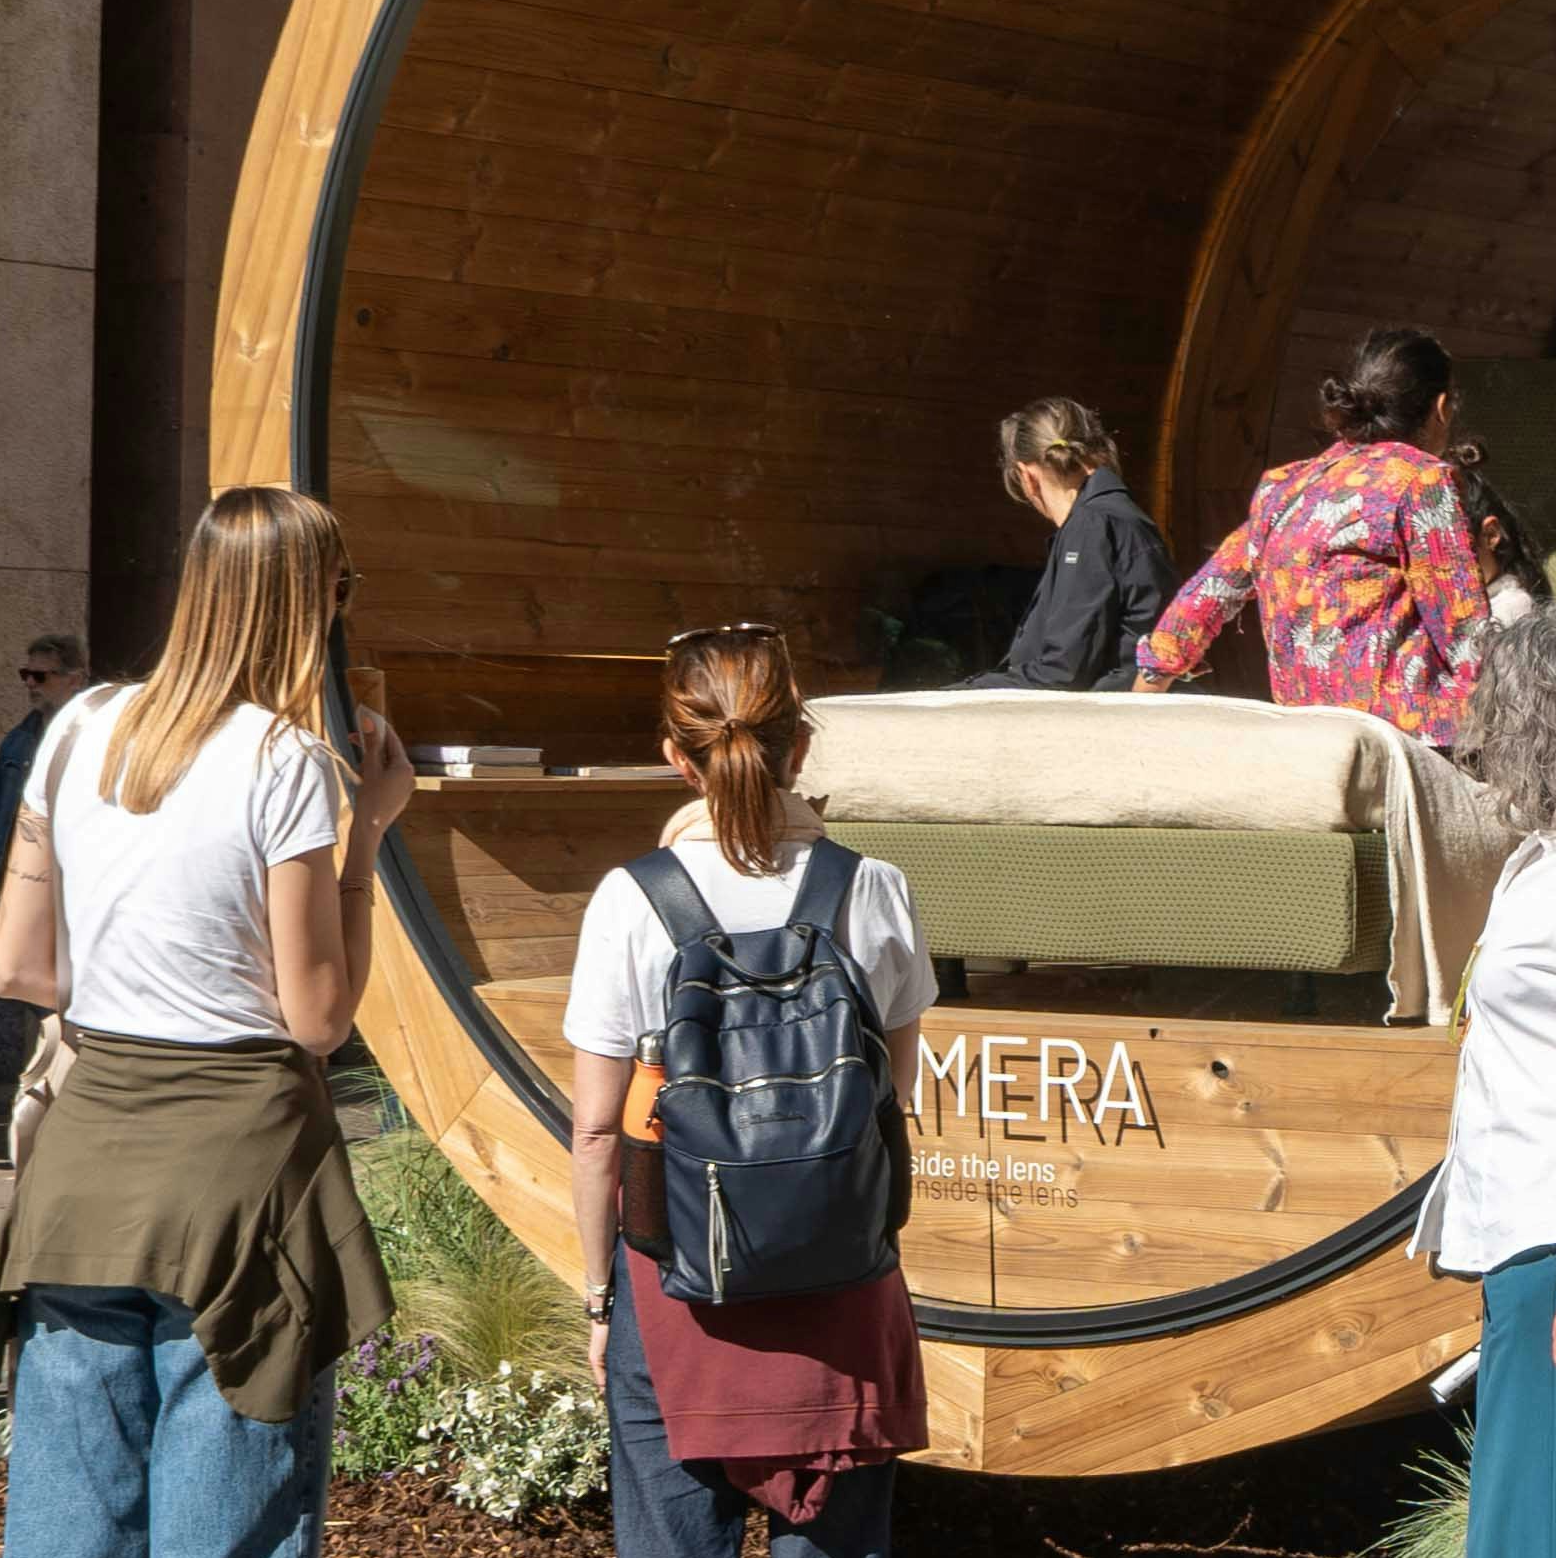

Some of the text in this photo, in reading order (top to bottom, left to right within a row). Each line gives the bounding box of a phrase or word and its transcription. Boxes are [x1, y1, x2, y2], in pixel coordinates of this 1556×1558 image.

[914, 1034, 1146, 1126] MERA
[910, 1150, 1056, 1183] side the lens
